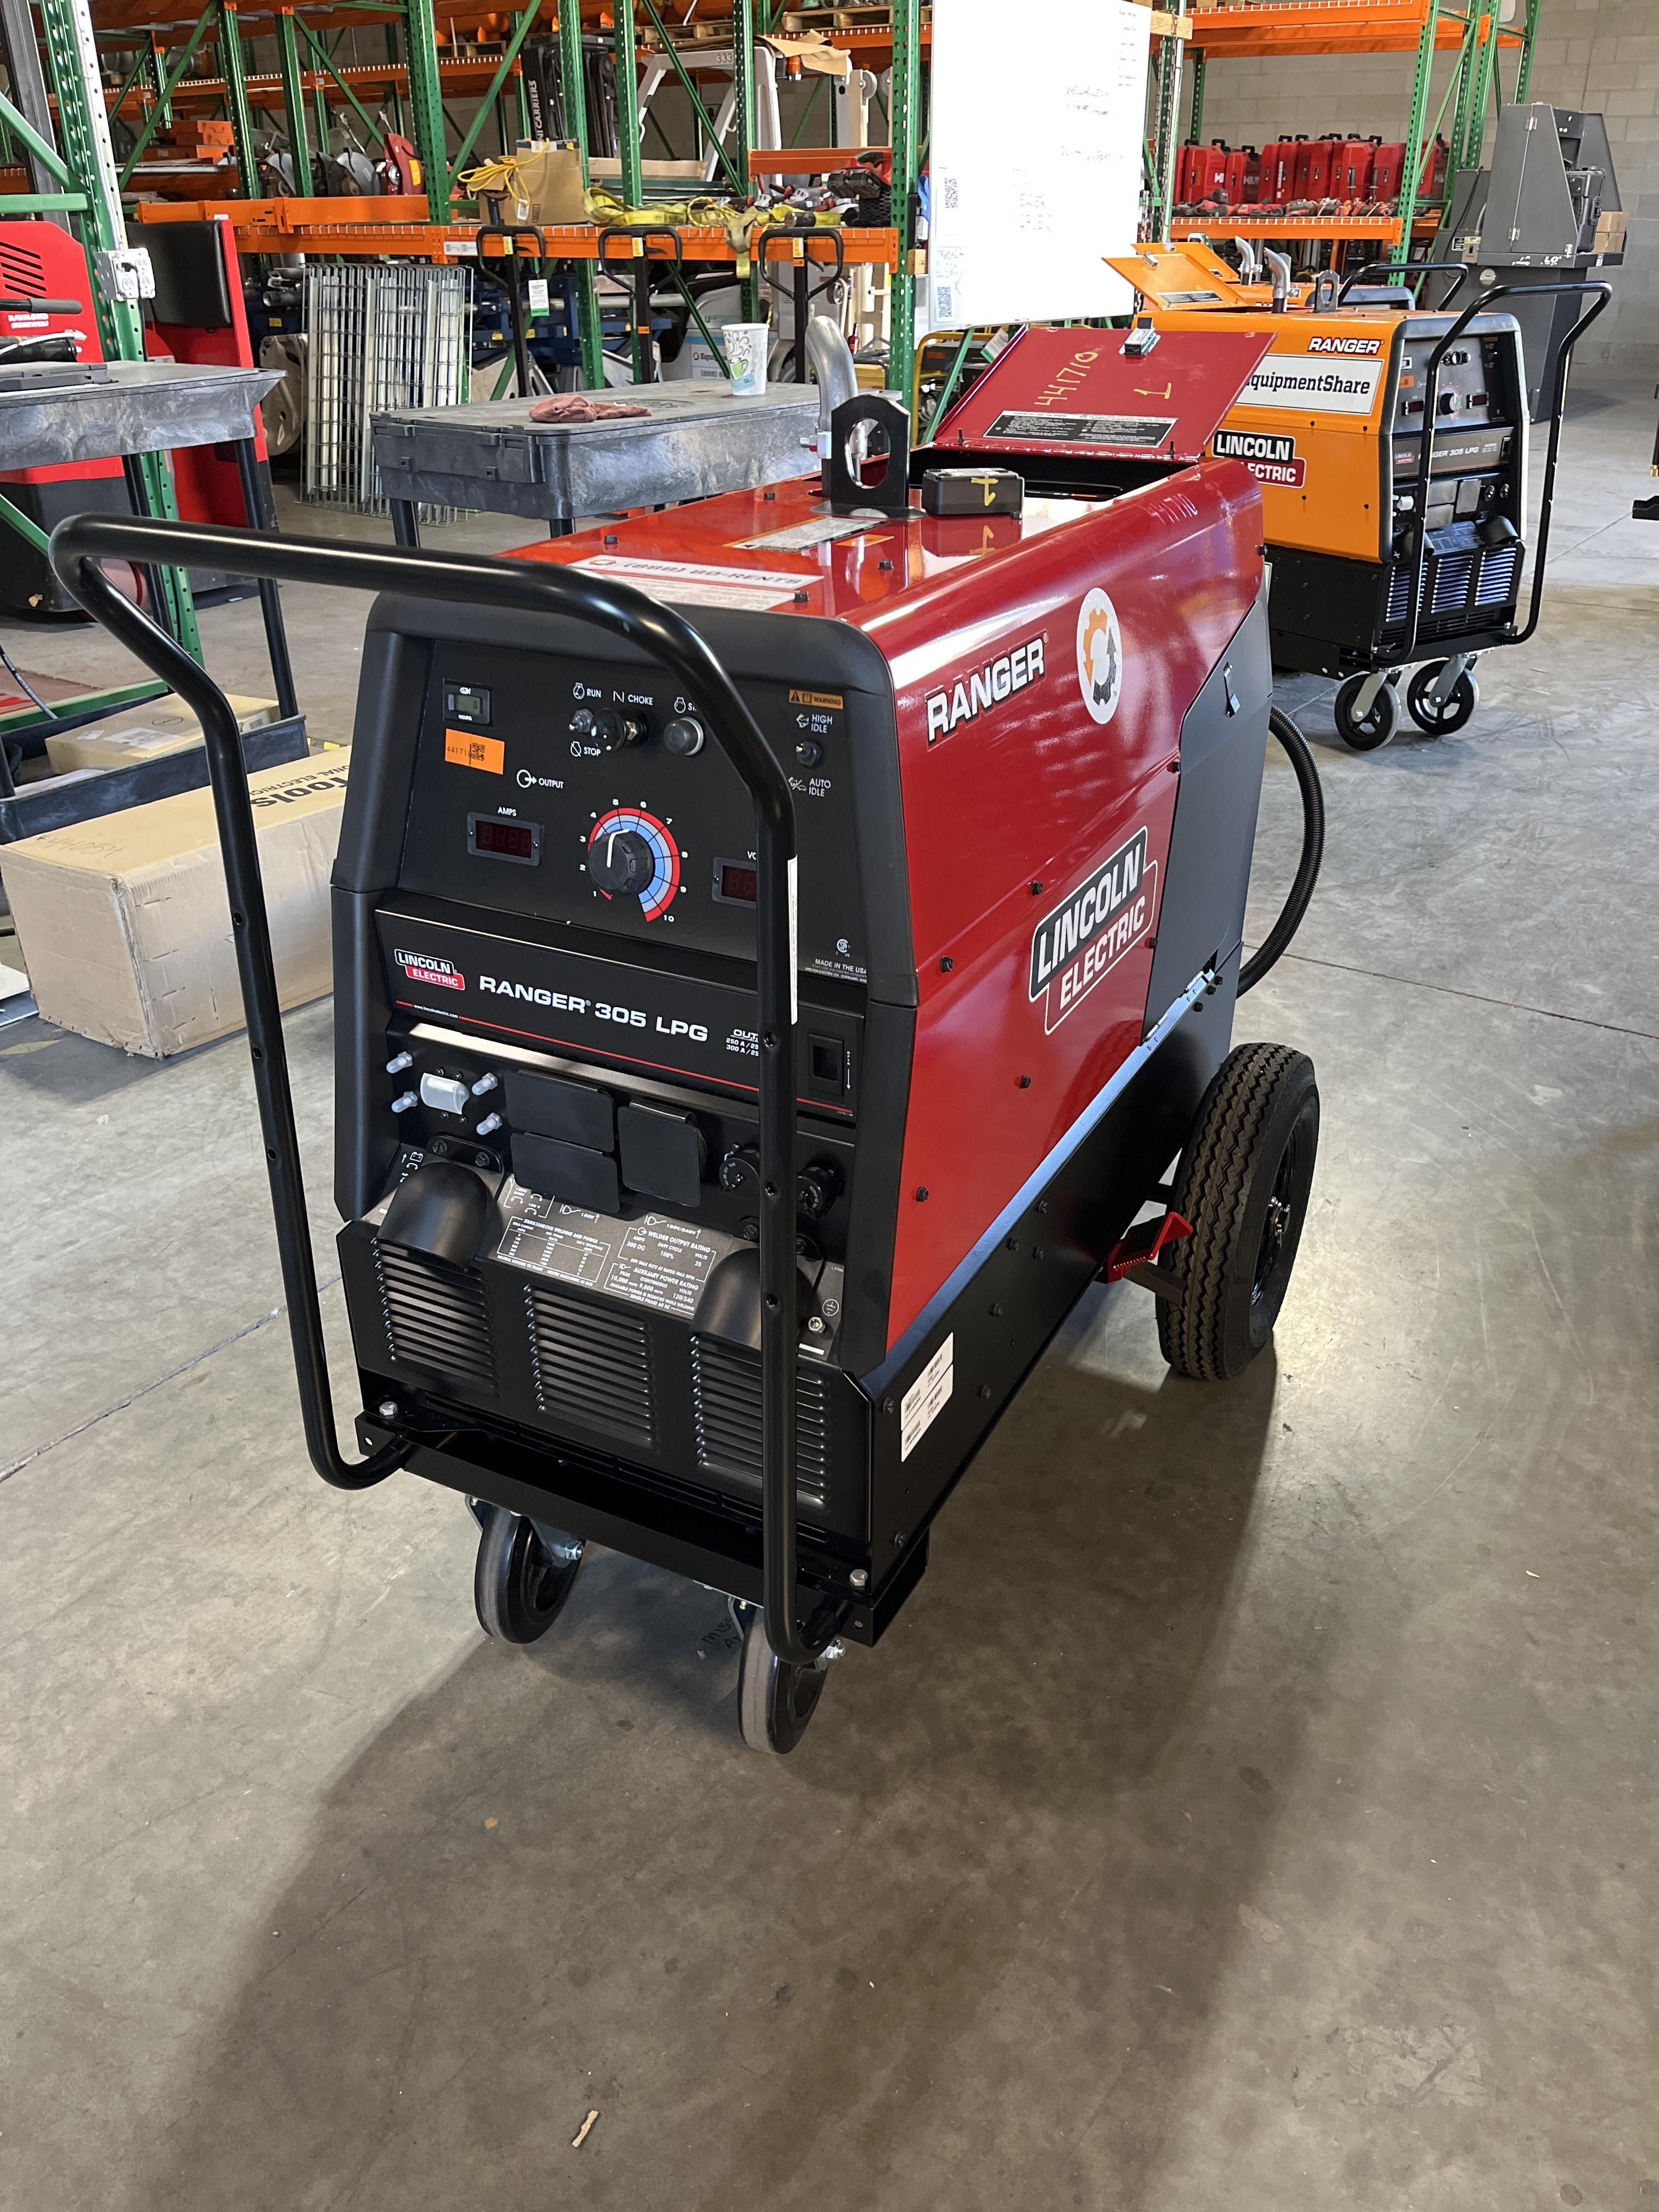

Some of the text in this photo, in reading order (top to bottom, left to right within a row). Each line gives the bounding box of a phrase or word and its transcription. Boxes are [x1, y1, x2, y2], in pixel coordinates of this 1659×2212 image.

[717, 53, 732, 64] 333
[1308, 337, 1380, 354] RANGER
[1033, 351, 1099, 406] 441710
[1245, 371, 1370, 394] quipmentShare
[1216, 434, 1290, 461] LINCOLN
[1247, 462, 1296, 483] ECTRIC
[586, 688, 601, 698] RUN
[928, 643, 1046, 743] RANGER
[628, 694, 653, 706] CHOKE
[814, 696, 841, 706] WARNING
[811, 713, 833, 725] HIGH
[811, 723, 827, 733] IDLE
[583, 746, 601, 756] STOP
[538, 777, 564, 789] OUTPUT
[809, 777, 831, 789] AUTO
[809, 786, 825, 797] IDLE
[498, 806, 517, 817] AMPS
[663, 914, 675, 923] 10
[1037, 843, 1142, 984] LINCOLN
[1059, 895, 1145, 1010] ELECTRIC
[398, 952, 451, 974] LINCOLN
[815, 958, 833, 967] MADE
[413, 968, 459, 986] ELECTRIC
[479, 975, 708, 1042] RANGER 305 LPG
[733, 1028, 759, 1040] OUT
[726, 1037, 738, 1046] 250
[726, 1044, 740, 1052] 300
[583, 1235, 599, 1244] POWER
[648, 1231, 711, 1254] WELDER OUTPUT RATING
[660, 1250, 674, 1259] 100%
[668, 1245, 682, 1253] CYCLE
[633, 1267, 699, 1290] AUXILIARY POWER RATING
[640, 1276, 668, 1289] CONTINUOUS
[673, 1293, 694, 1304] 120/240
